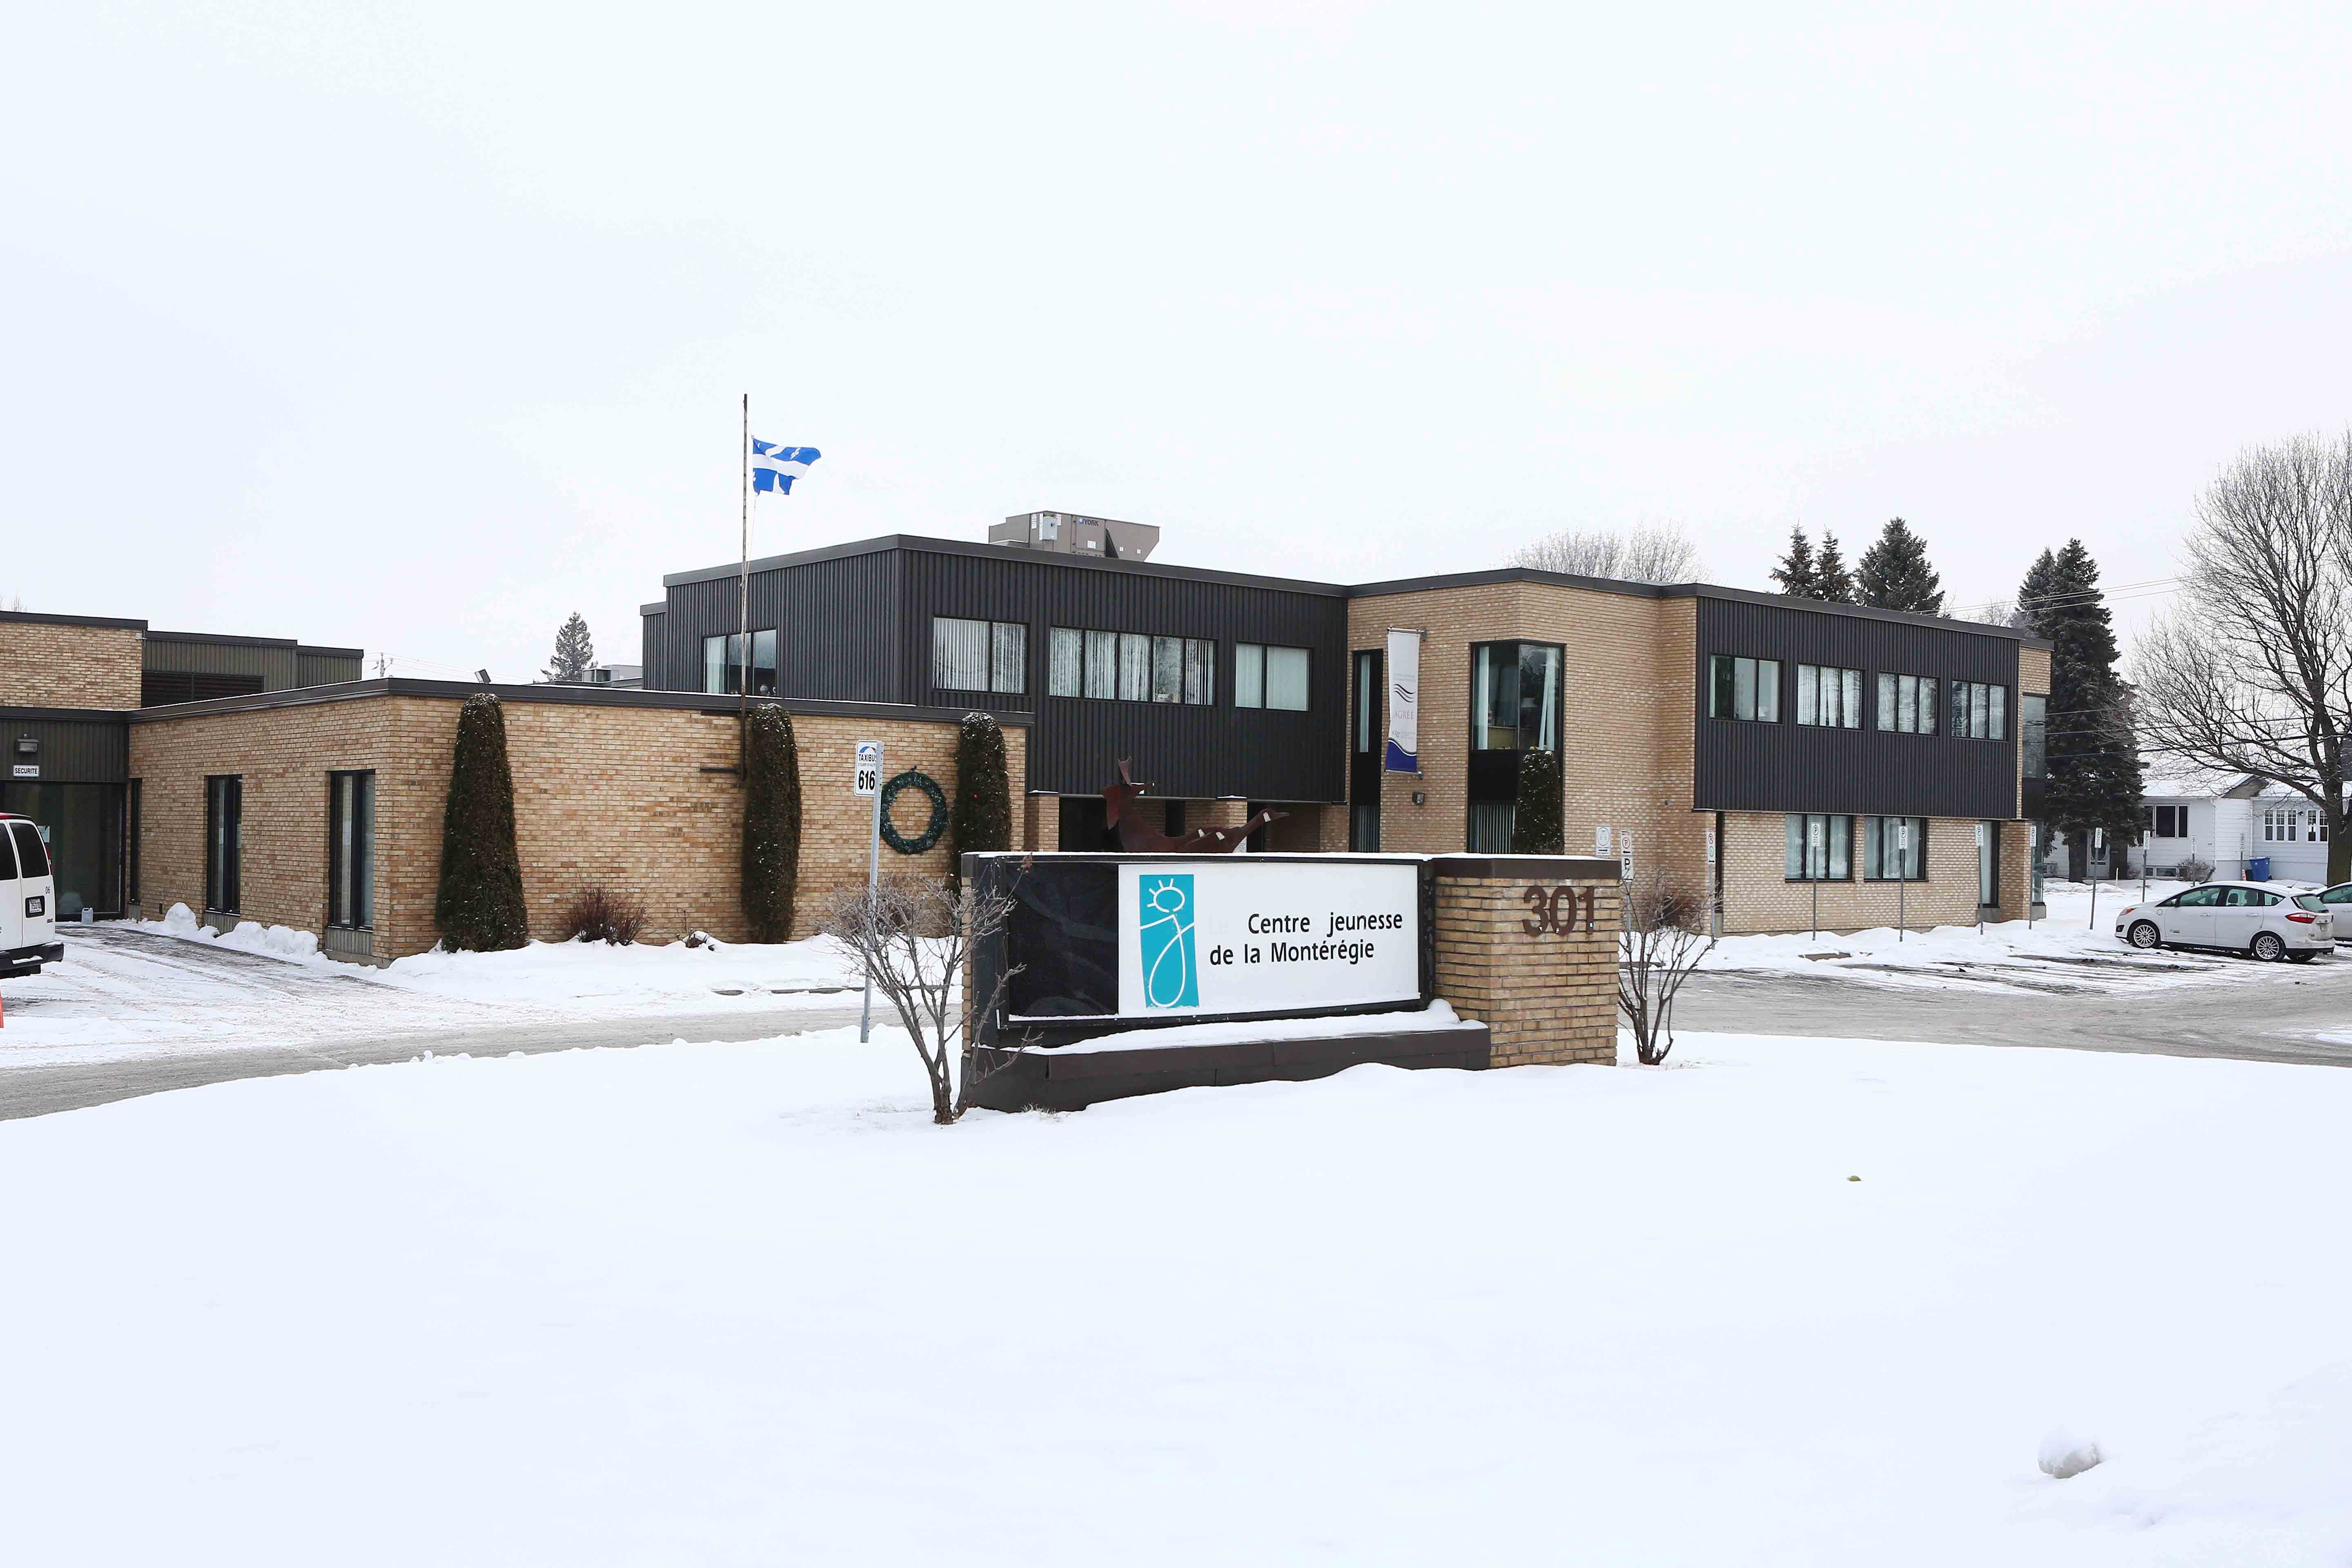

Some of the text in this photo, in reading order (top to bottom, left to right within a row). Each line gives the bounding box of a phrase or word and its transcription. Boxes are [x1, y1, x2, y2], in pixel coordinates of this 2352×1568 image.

[858, 770, 875, 790] 616
[1625, 858, 1630, 870] P
[45, 886, 50, 894] 06
[1523, 886, 1595, 937] 301
[1248, 913, 1310, 934] Centre
[1326, 912, 1403, 938] jeunesse
[1210, 939, 1374, 965] de la Montérégie
